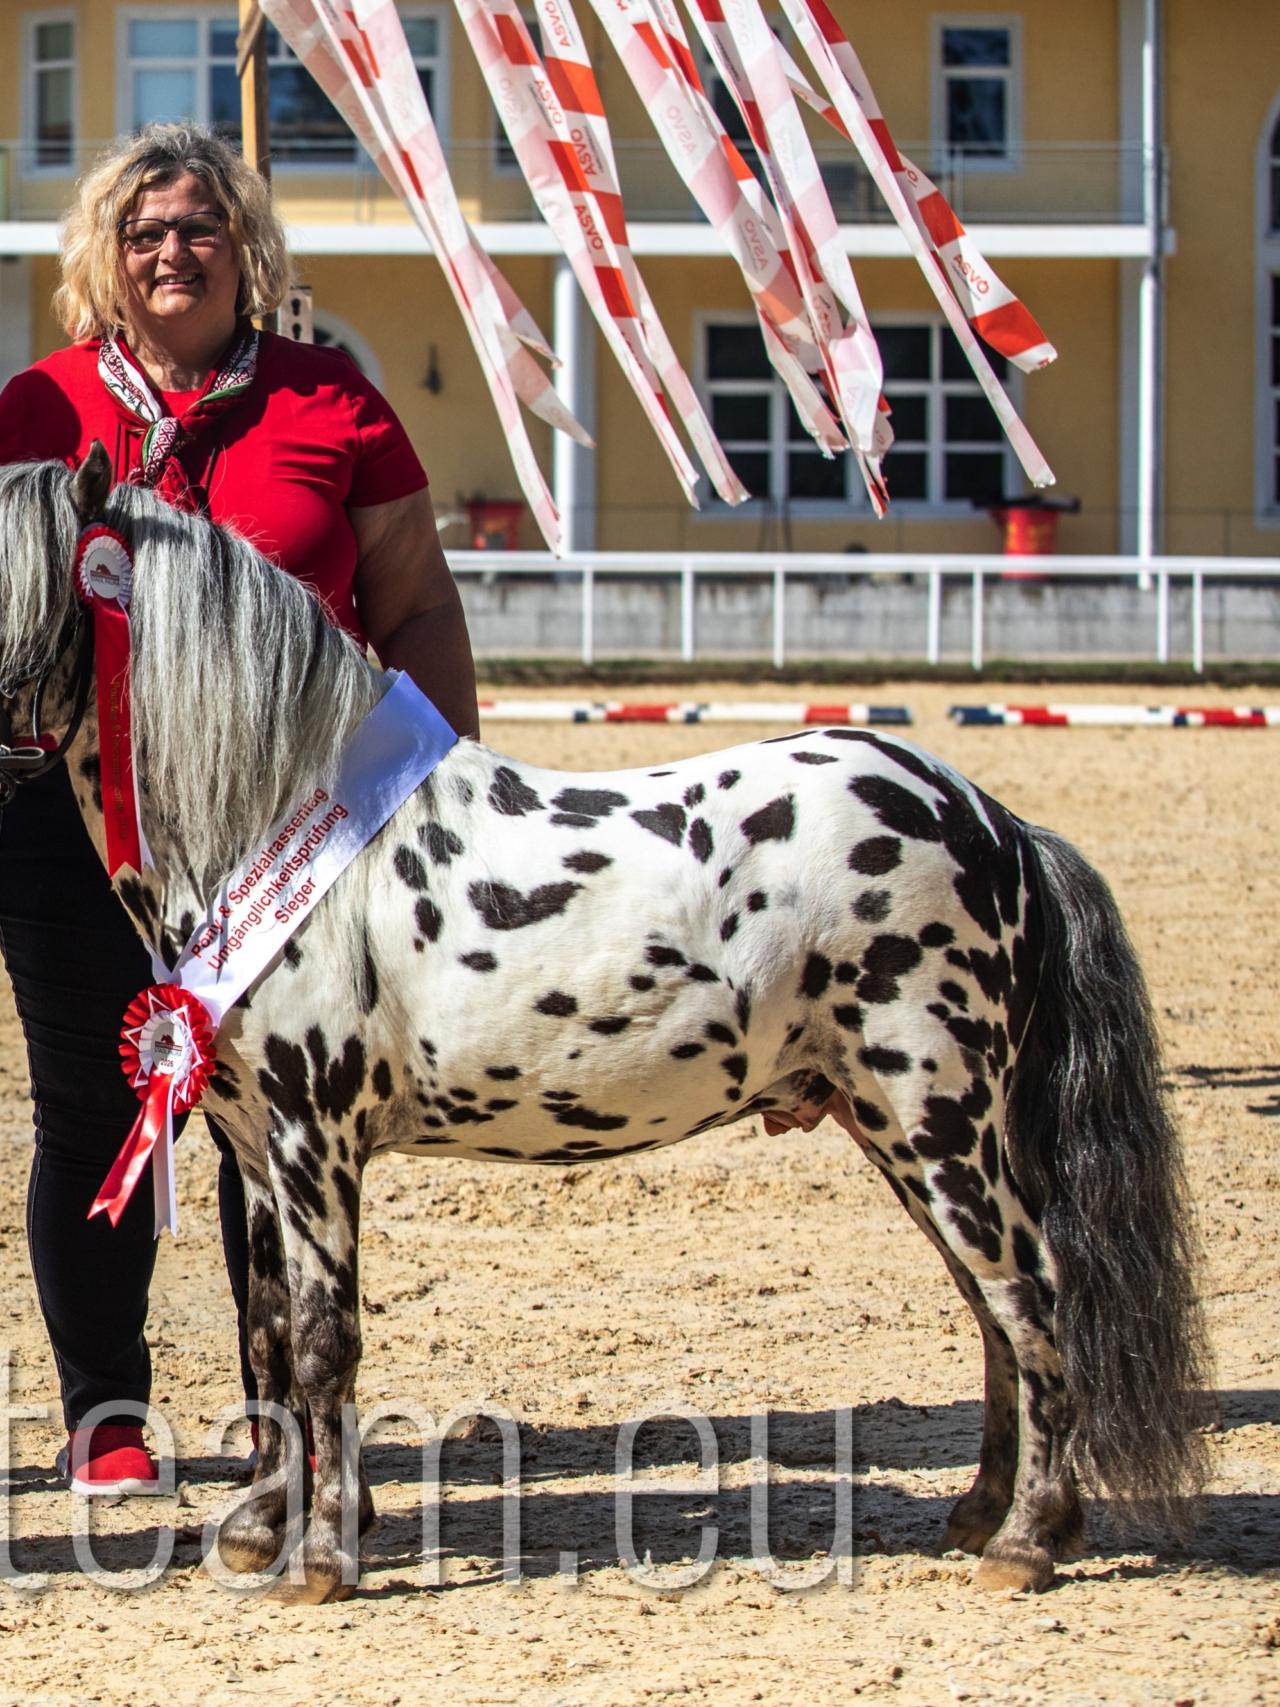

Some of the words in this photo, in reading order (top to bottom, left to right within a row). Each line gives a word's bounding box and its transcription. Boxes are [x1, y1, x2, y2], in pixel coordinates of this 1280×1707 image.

[191, 919, 224, 959] Pony
[218, 905, 234, 918] &
[228, 787, 329, 904] Spezialrassentag
[208, 803, 349, 971] Umgänglichkeitsprüfung
[275, 877, 317, 924] Sieger
